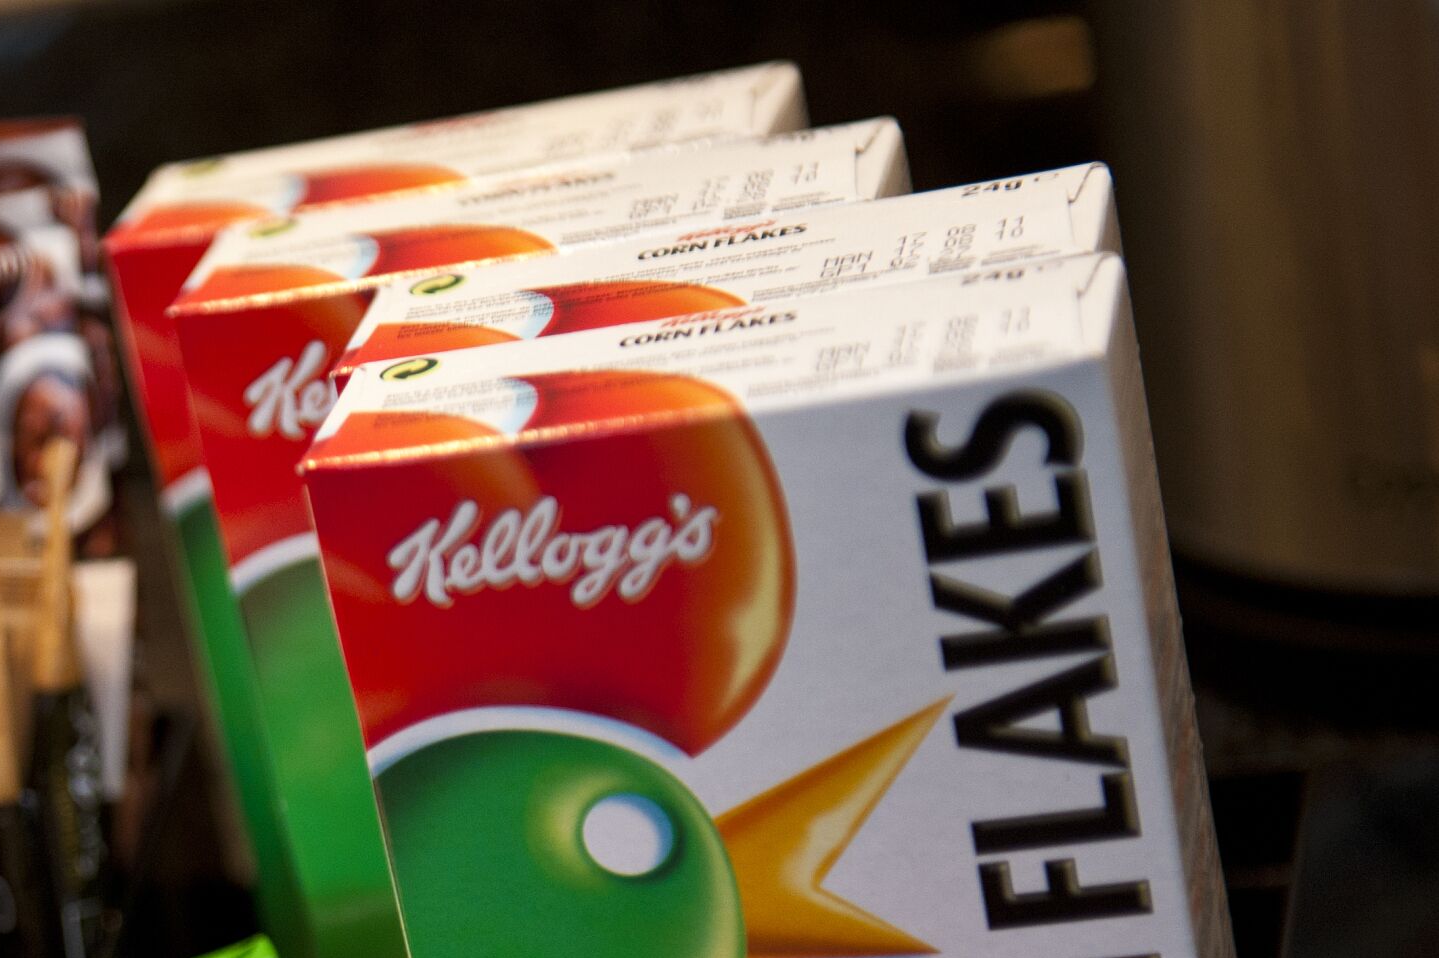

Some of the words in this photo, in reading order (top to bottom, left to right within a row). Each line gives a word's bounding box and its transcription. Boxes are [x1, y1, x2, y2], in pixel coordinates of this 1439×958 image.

[637, 239, 709, 261] CORN
[713, 222, 809, 249] FLAKES
[618, 326, 693, 349] CORN
[698, 309, 798, 337] FLAKES
[387, 492, 720, 610] Kellogg's
[902, 386, 1155, 932] FLAKES
